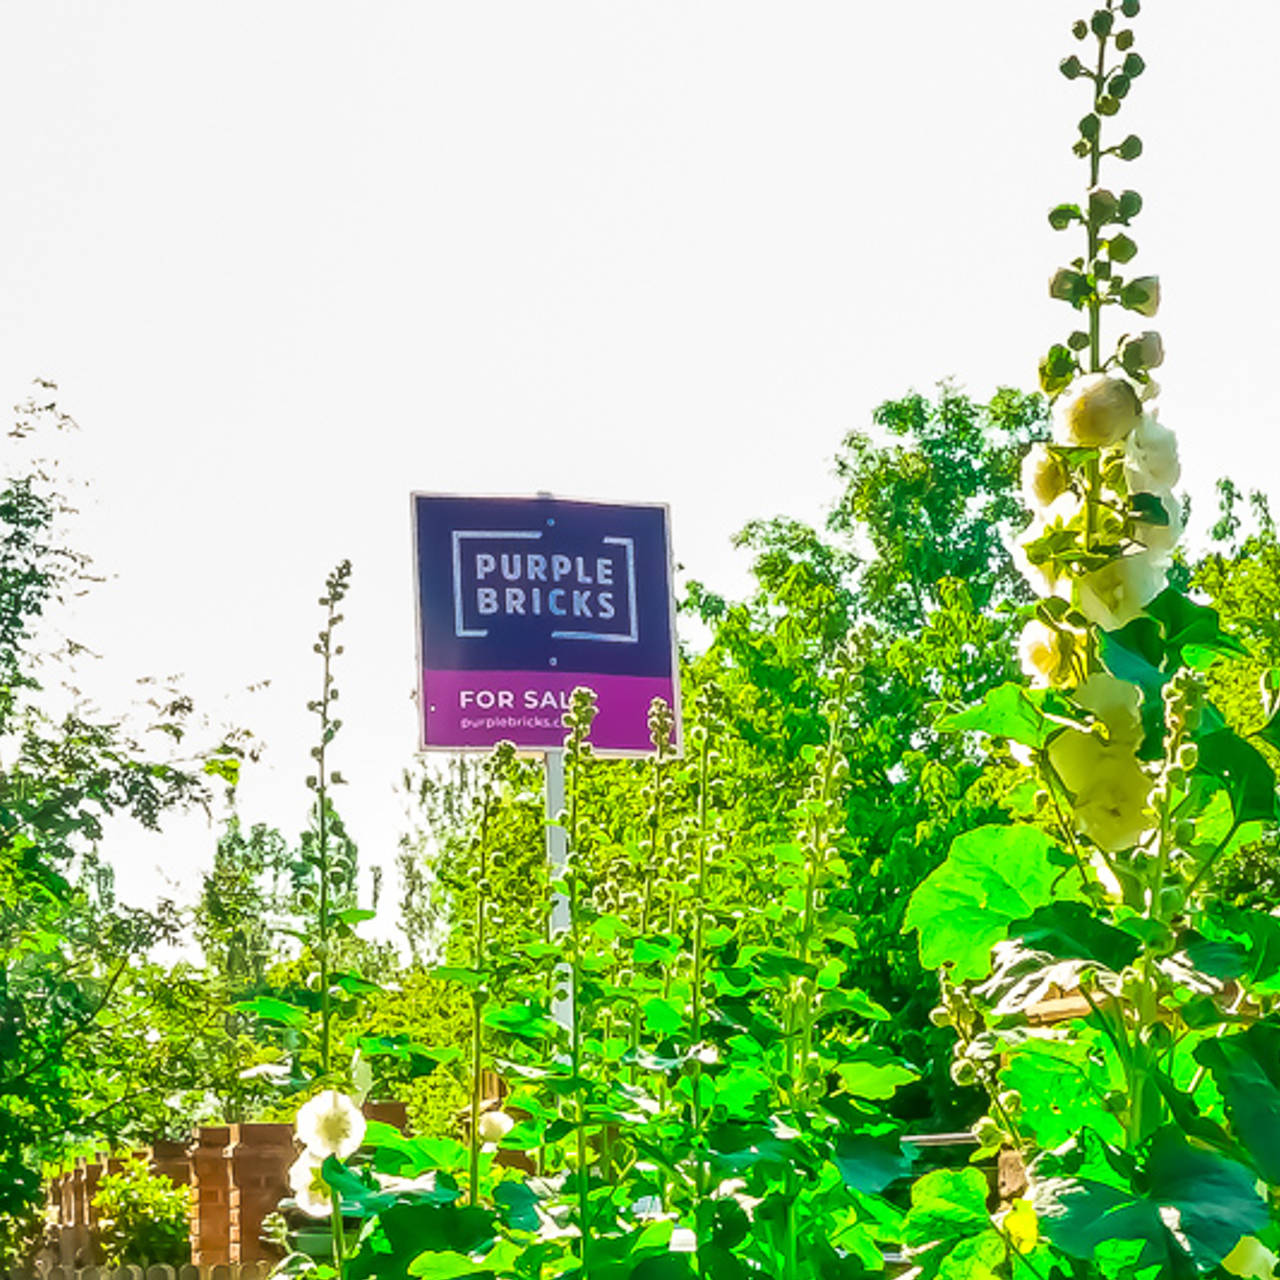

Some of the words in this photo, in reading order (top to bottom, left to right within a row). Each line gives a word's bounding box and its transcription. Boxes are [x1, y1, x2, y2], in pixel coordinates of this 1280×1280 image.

[476, 553, 614, 585] PURPLE
[476, 587, 616, 619] BRICKS
[459, 690, 515, 709] FOR
[523, 690, 571, 709] SAL
[460, 716, 563, 729] purplebricks.c
